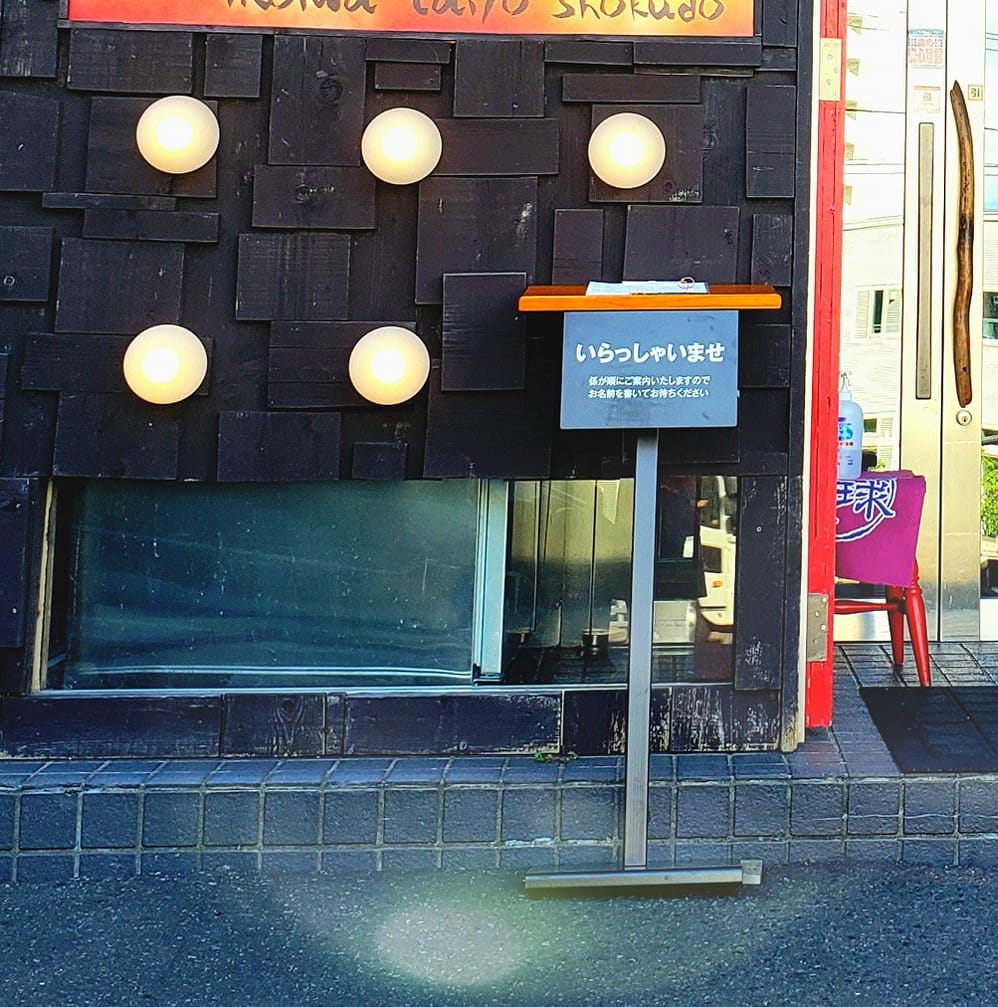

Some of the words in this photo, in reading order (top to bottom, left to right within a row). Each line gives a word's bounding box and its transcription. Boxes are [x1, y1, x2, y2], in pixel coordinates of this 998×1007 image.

[575, 342, 726, 364] いらっしゃいませ
[588, 375, 711, 386] 係が順にご案内いたしますので
[587, 388, 710, 399] お名前を書いてお待ちください
